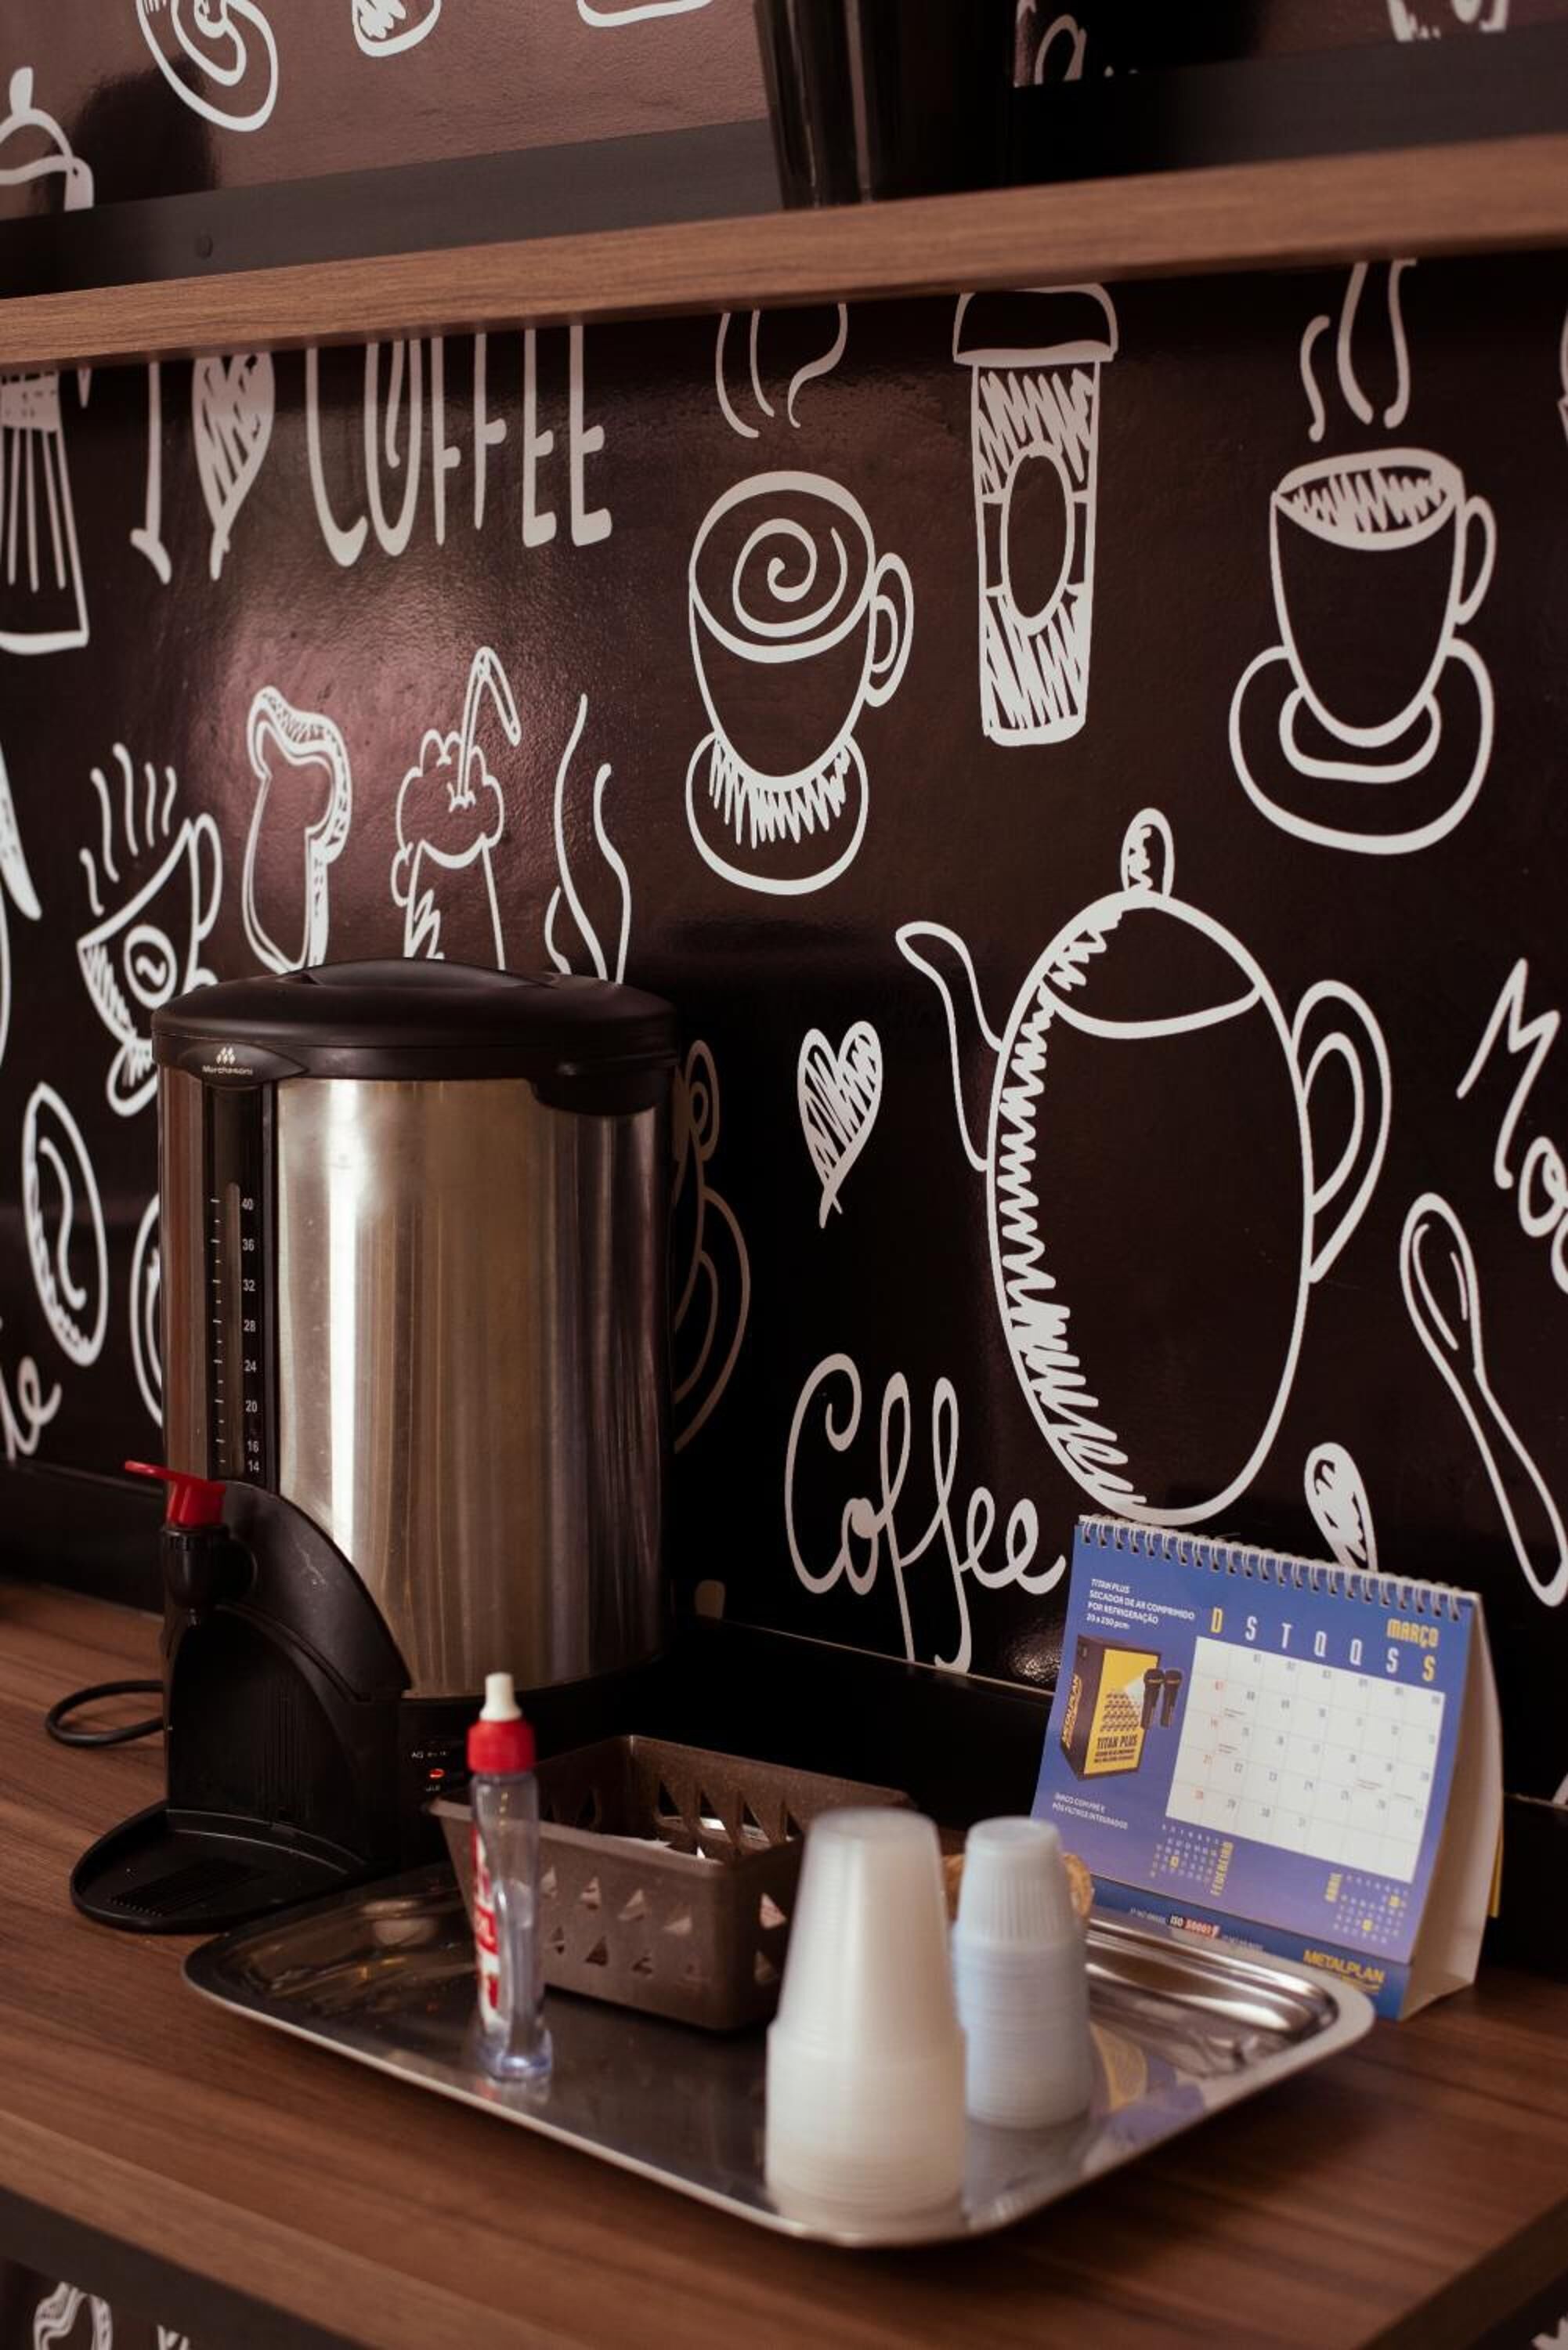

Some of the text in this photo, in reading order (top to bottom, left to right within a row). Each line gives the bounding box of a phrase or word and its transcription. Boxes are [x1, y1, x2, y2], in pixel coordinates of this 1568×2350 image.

[242, 1198, 254, 1211] 40
[243, 1239, 255, 1252] 36
[244, 1279, 255, 1292] 32
[244, 1319, 256, 1332] 28
[244, 1360, 257, 1372] 24
[245, 1400, 258, 1412] 20
[247, 1441, 258, 1453] 16
[248, 1461, 259, 1473] 14
[785, 1354, 1066, 1673] Coffee
[1210, 1607, 1436, 1682] D S T Q Q S S
[1303, 1949, 1385, 1983] METALPLAN
